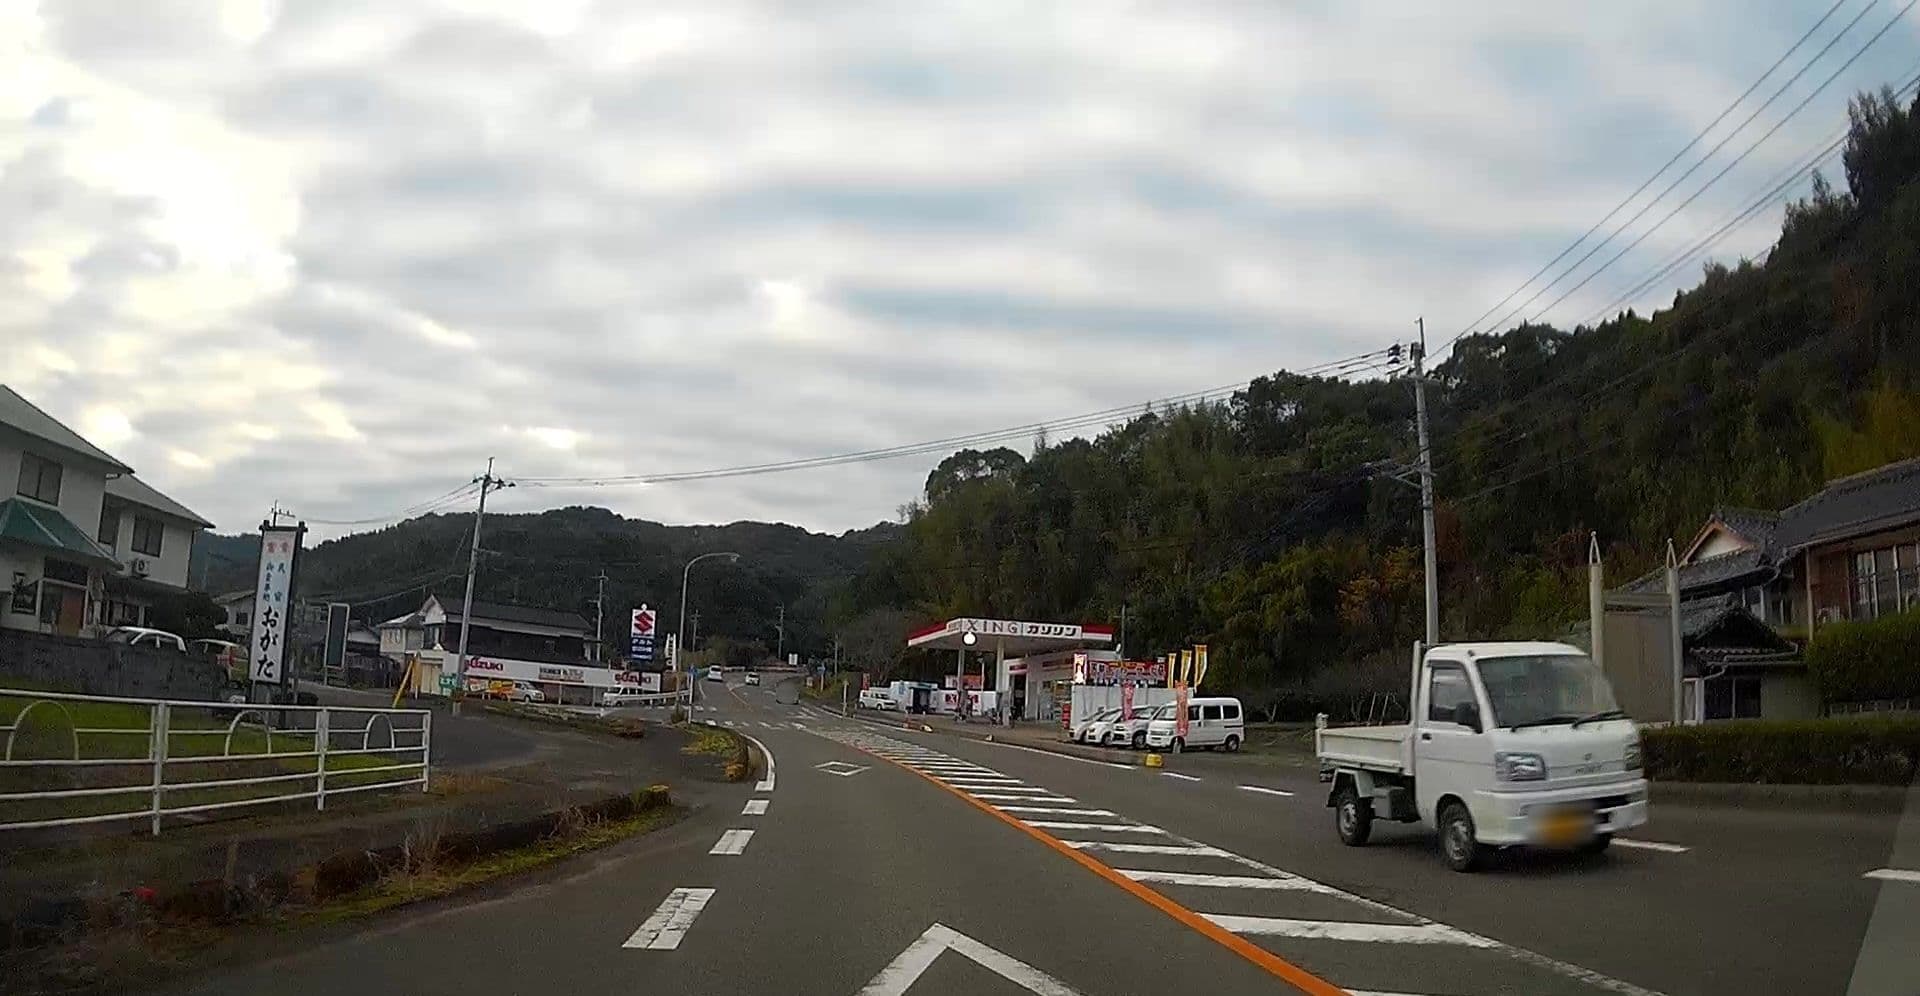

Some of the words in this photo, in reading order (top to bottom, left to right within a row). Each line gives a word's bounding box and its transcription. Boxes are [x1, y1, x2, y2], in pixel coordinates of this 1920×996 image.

[967, 618, 1019, 634] XING
[1027, 624, 1077, 637] ガソリン
[256, 605, 279, 679] おがた
